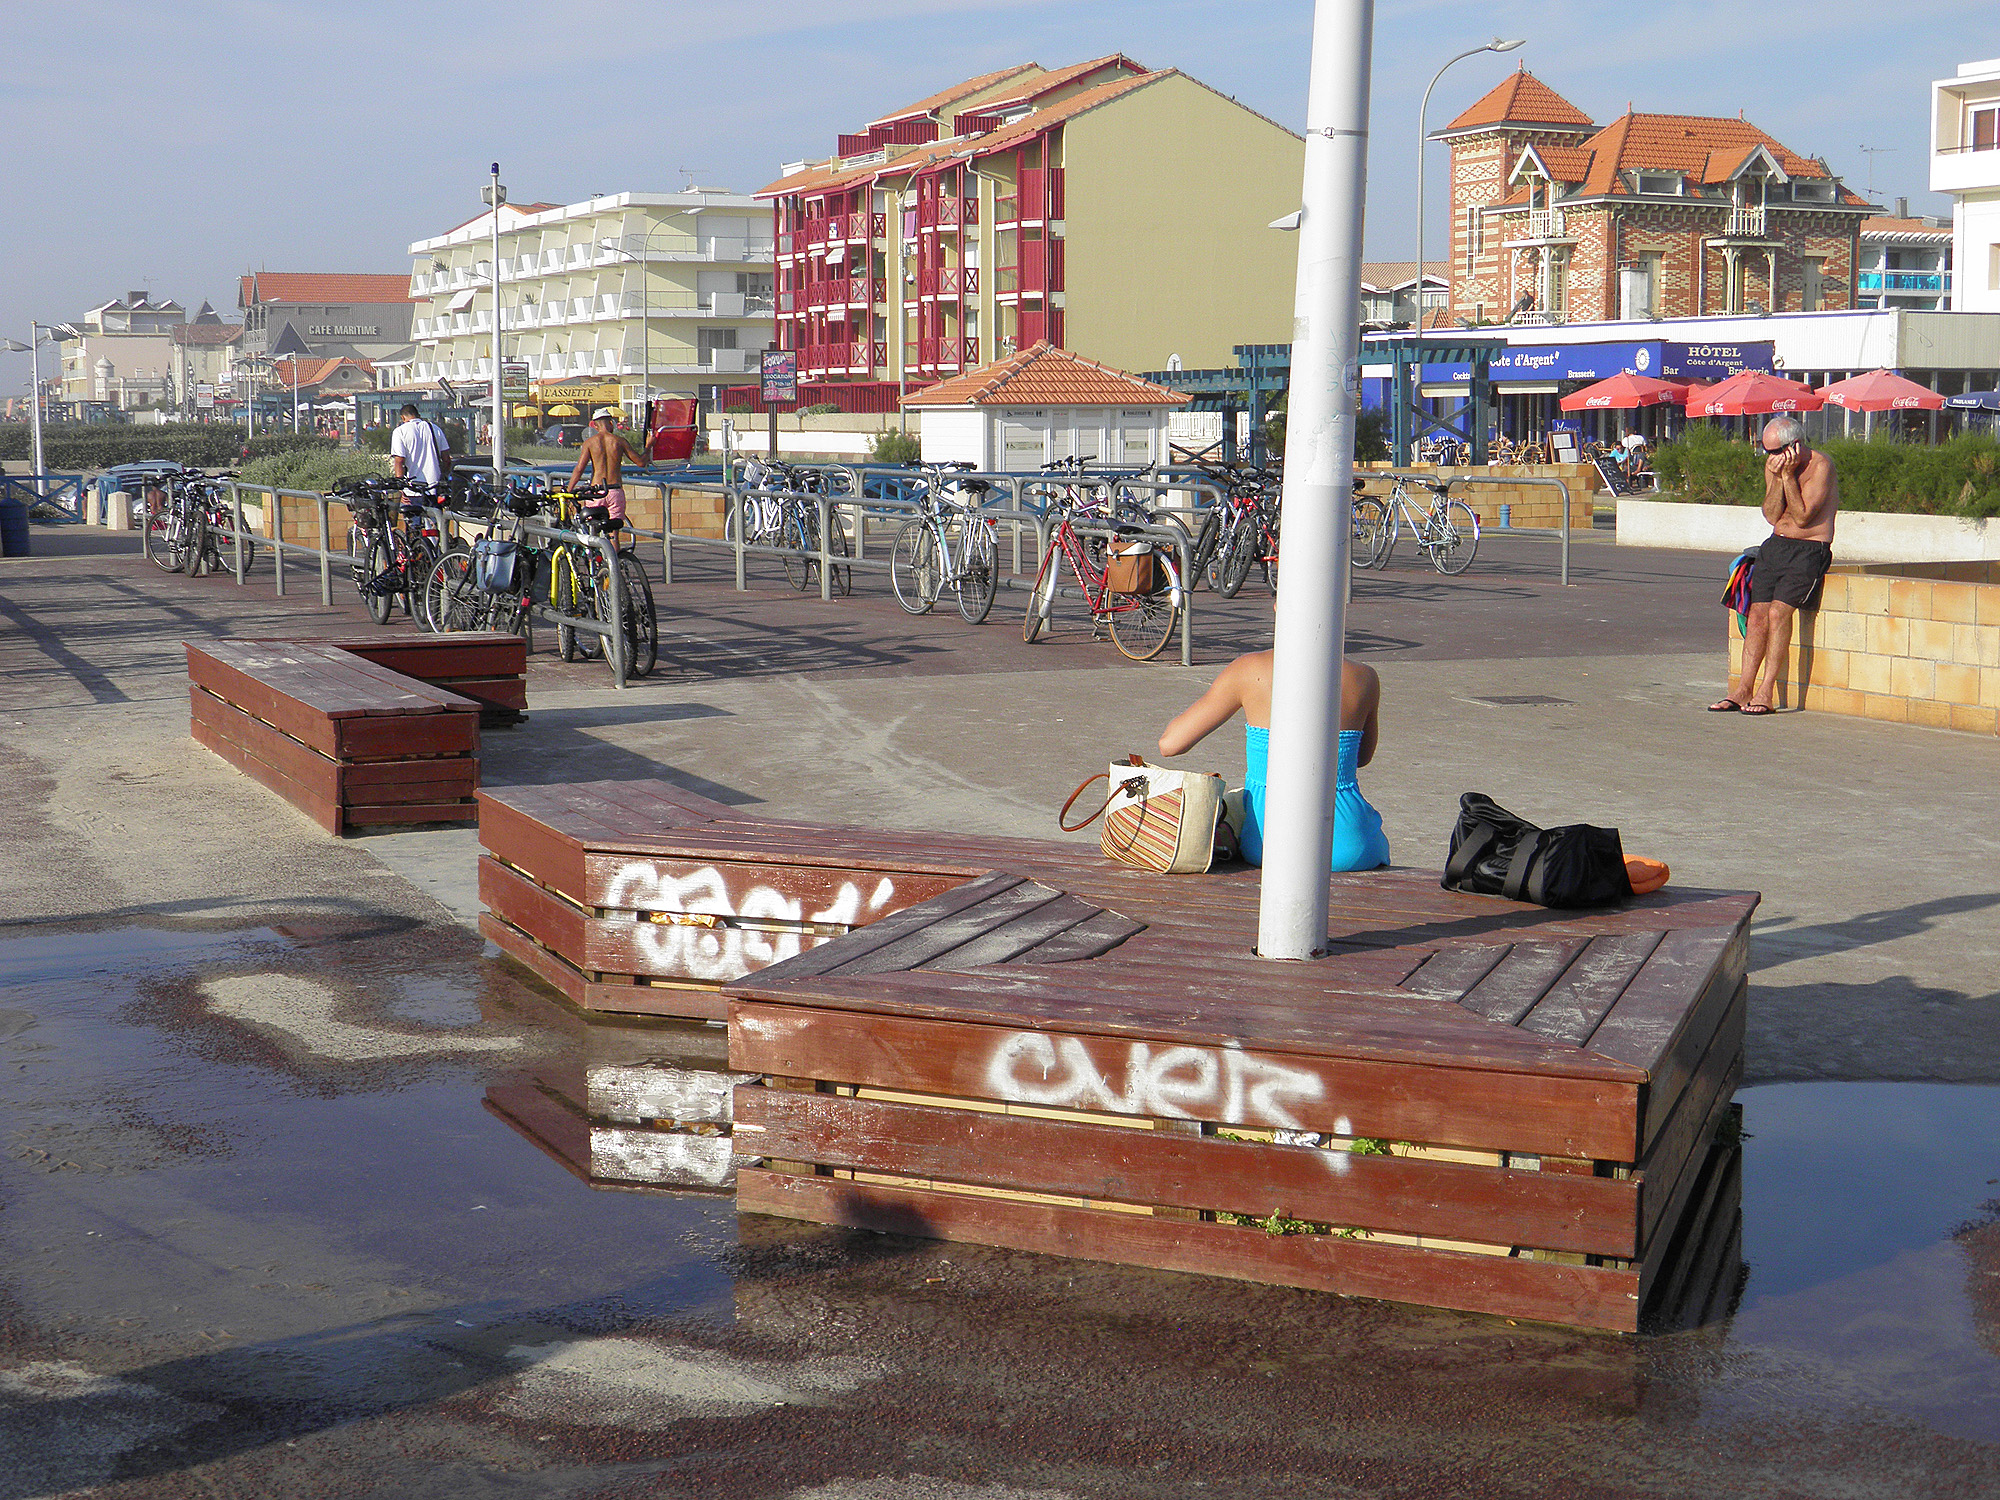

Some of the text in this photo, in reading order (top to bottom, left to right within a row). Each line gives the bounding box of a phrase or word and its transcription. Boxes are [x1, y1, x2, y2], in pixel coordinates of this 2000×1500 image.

[308, 325, 377, 335] CAFE MARITIME
[1688, 345, 1741, 357] HÔTEL
[1567, 369, 1596, 379] Brasserie
[1624, 367, 1638, 376] Bar
[1663, 366, 1679, 375] Bar
[544, 388, 594, 397] L'ASSIETTE
